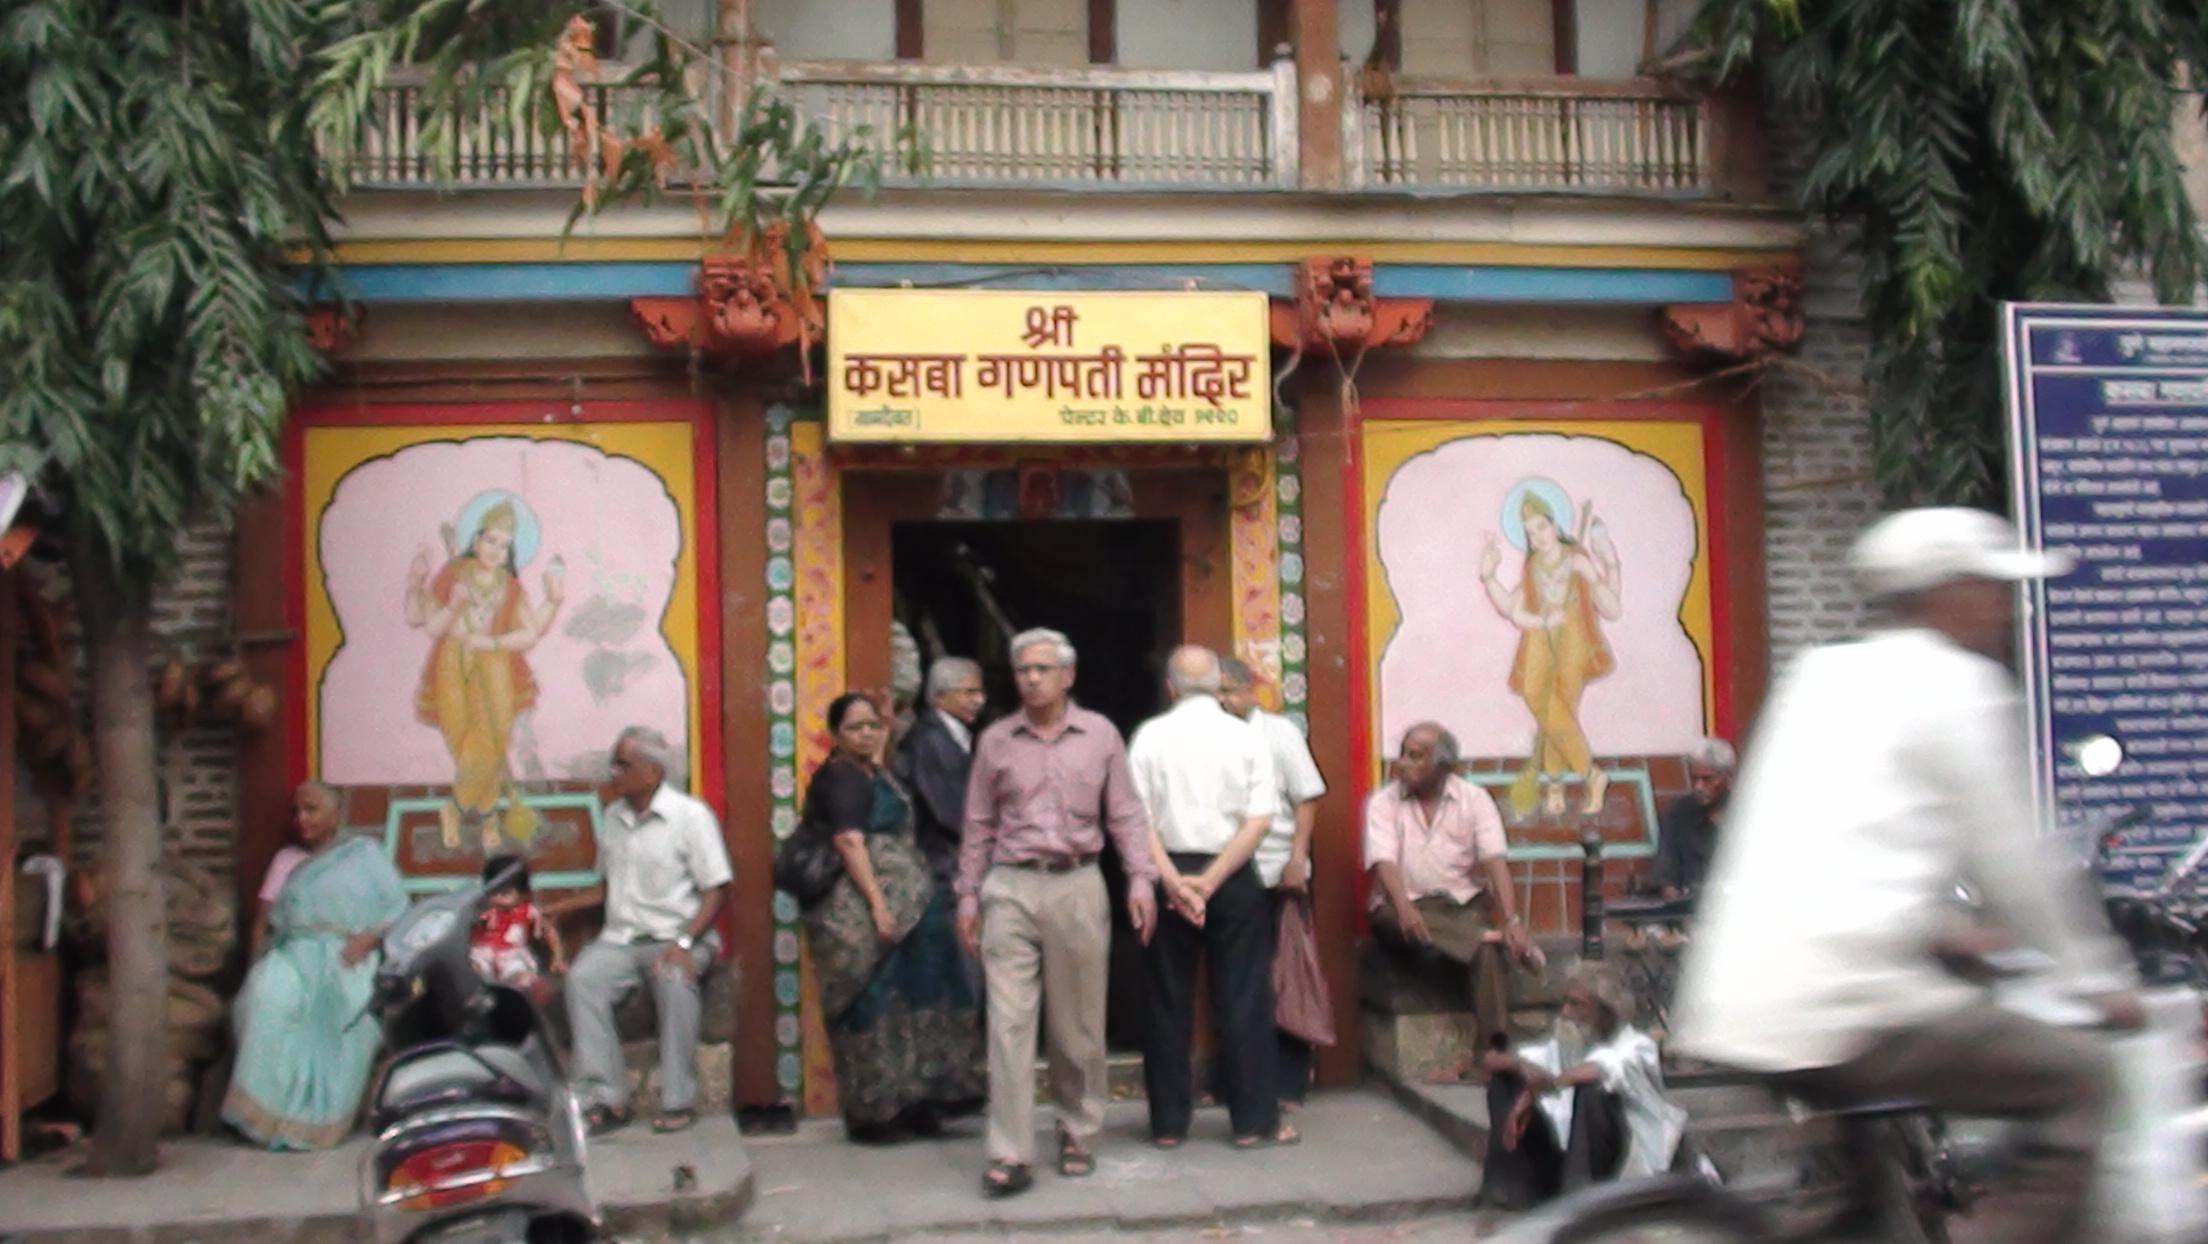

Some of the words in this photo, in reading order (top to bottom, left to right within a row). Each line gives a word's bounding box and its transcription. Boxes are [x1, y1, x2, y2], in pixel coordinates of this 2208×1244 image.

[1021, 305, 1079, 349] श्री
[843, 353, 968, 400] कसबा
[976, 345, 1128, 400] गणपती
[1134, 343, 1257, 408] मंदिर
